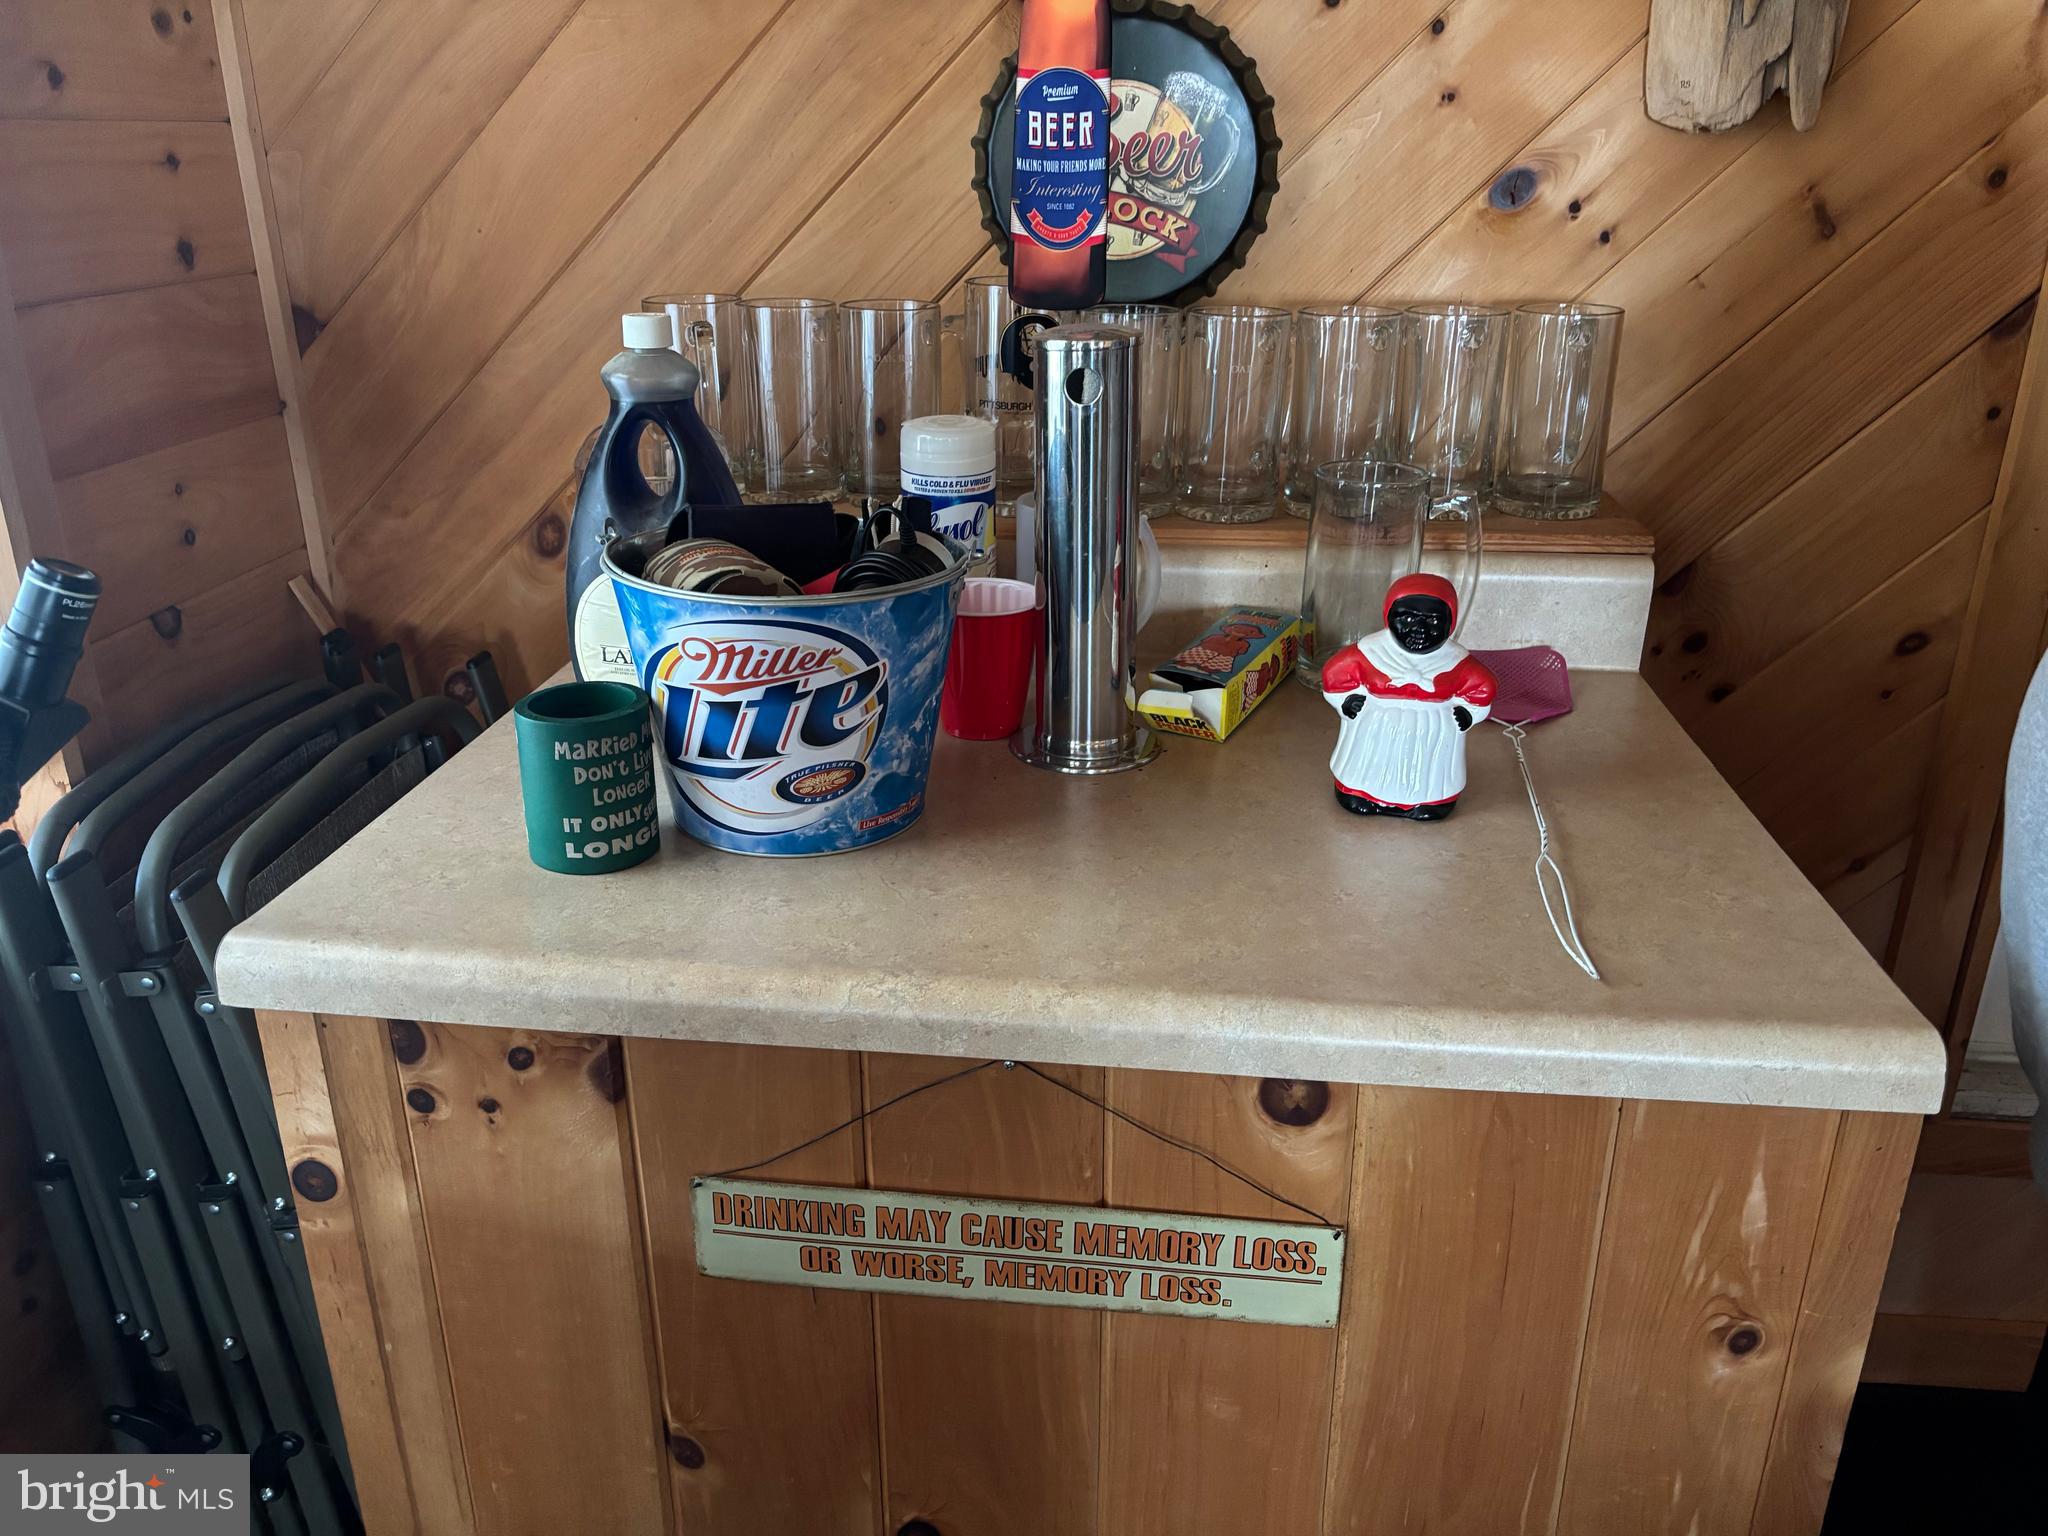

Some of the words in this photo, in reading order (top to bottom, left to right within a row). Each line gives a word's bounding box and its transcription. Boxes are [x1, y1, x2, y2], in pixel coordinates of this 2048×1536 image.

[1042, 83, 1079, 97] Premium
[1028, 110, 1093, 149] BEER
[1016, 157, 1042, 172] MAKING
[1043, 160, 1060, 173] YOUR
[1060, 159, 1088, 173] FRIENDS
[1088, 157, 1107, 171] MORE
[1024, 175, 1101, 204] Interesting
[1046, 202, 1062, 210] SINCE
[1112, 198, 1188, 242] OCK
[979, 399, 1032, 411] PITTSBURGH
[911, 477, 929, 487] KILLS
[929, 480, 948, 488] COLD
[955, 480, 969, 488] FLU
[682, 637, 843, 681] Miller
[1149, 713, 1210, 731] BLACK
[785, 767, 811, 784] TRUE
[815, 761, 857, 772] PILSNER
[563, 817, 582, 833] IT
[591, 805, 643, 833] ONLY
[863, 819, 876, 829] Live
[565, 820, 660, 859] LONGE
[712, 1191, 865, 1238] DRINKING
[875, 1205, 951, 1243] MAY
[960, 1213, 1063, 1253] CAUSE
[1074, 1221, 1225, 1266] MEMORY
[1233, 1236, 1327, 1276] LOSS.
[799, 1246, 842, 1275] OR
[851, 1249, 974, 1289] WORSE,
[984, 1259, 1131, 1297] MEMORY
[1141, 1272, 1232, 1307] LOSS.
